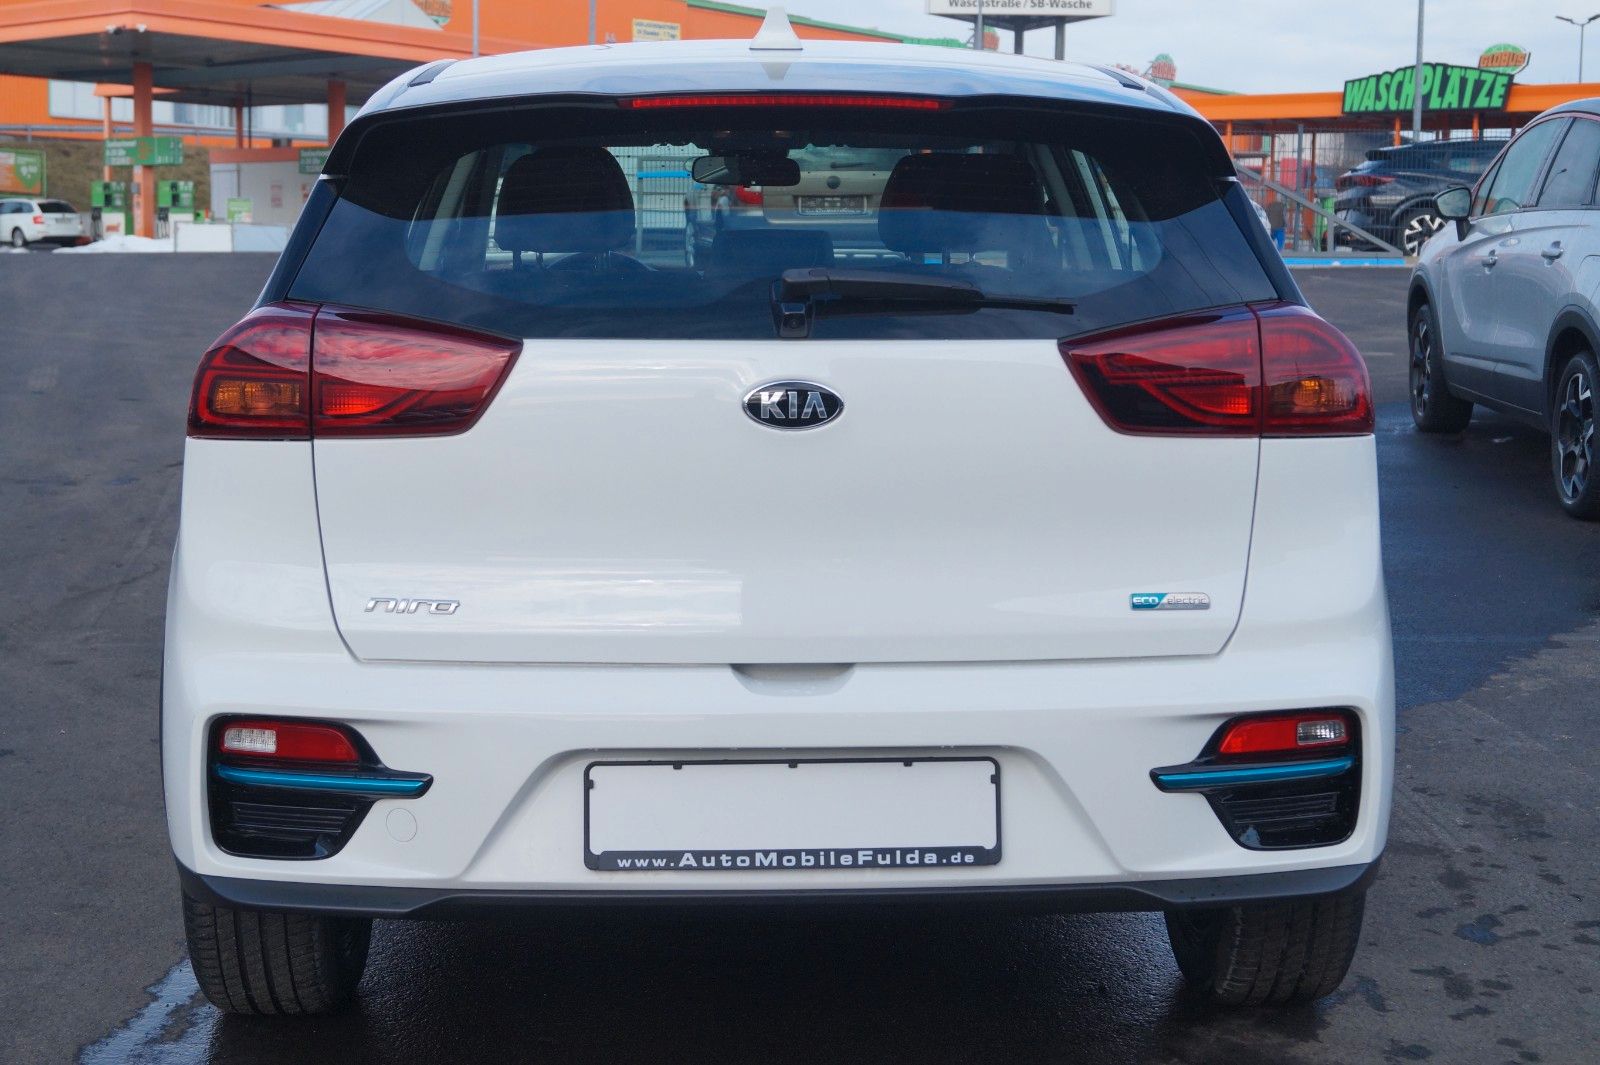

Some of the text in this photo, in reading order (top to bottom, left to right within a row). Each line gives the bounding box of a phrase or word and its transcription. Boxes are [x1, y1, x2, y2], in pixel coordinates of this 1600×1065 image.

[1480, 51, 1526, 68] GLOBUS
[1343, 63, 1510, 113] WASCHPLÄTZE
[760, 391, 828, 419] KIA
[1167, 595, 1208, 605] electric
[616, 850, 975, 868] www.AutoMobileFulda.de
